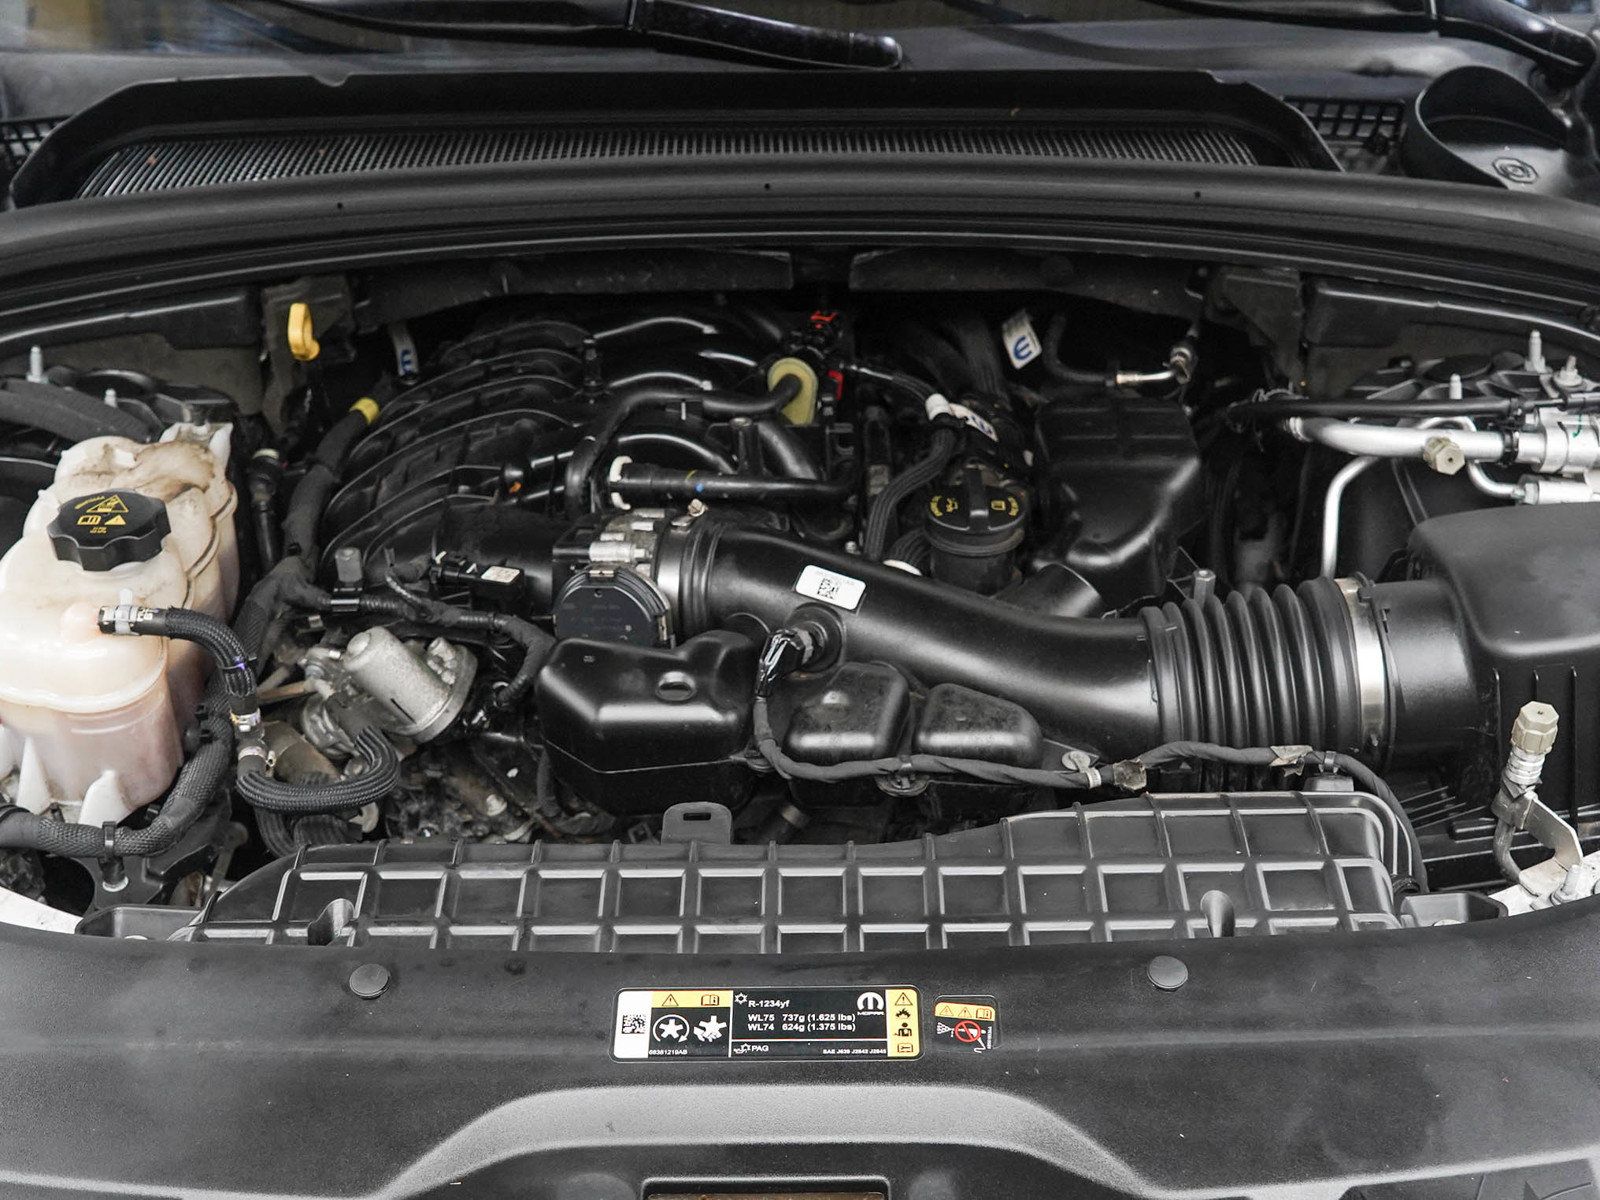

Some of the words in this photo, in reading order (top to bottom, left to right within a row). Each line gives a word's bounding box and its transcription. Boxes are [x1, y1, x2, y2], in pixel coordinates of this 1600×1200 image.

[748, 1000, 790, 1009] R-1234yf
[747, 1013, 775, 1022] WL75
[782, 1013, 805, 1023] 737g
[807, 1013, 836, 1022] (1.625
[838, 1013, 856, 1022] lbs)
[747, 1023, 775, 1031] WL74
[781, 1023, 805, 1032] 624g
[807, 1023, 836, 1032] (1.375
[838, 1023, 856, 1032] lbs)
